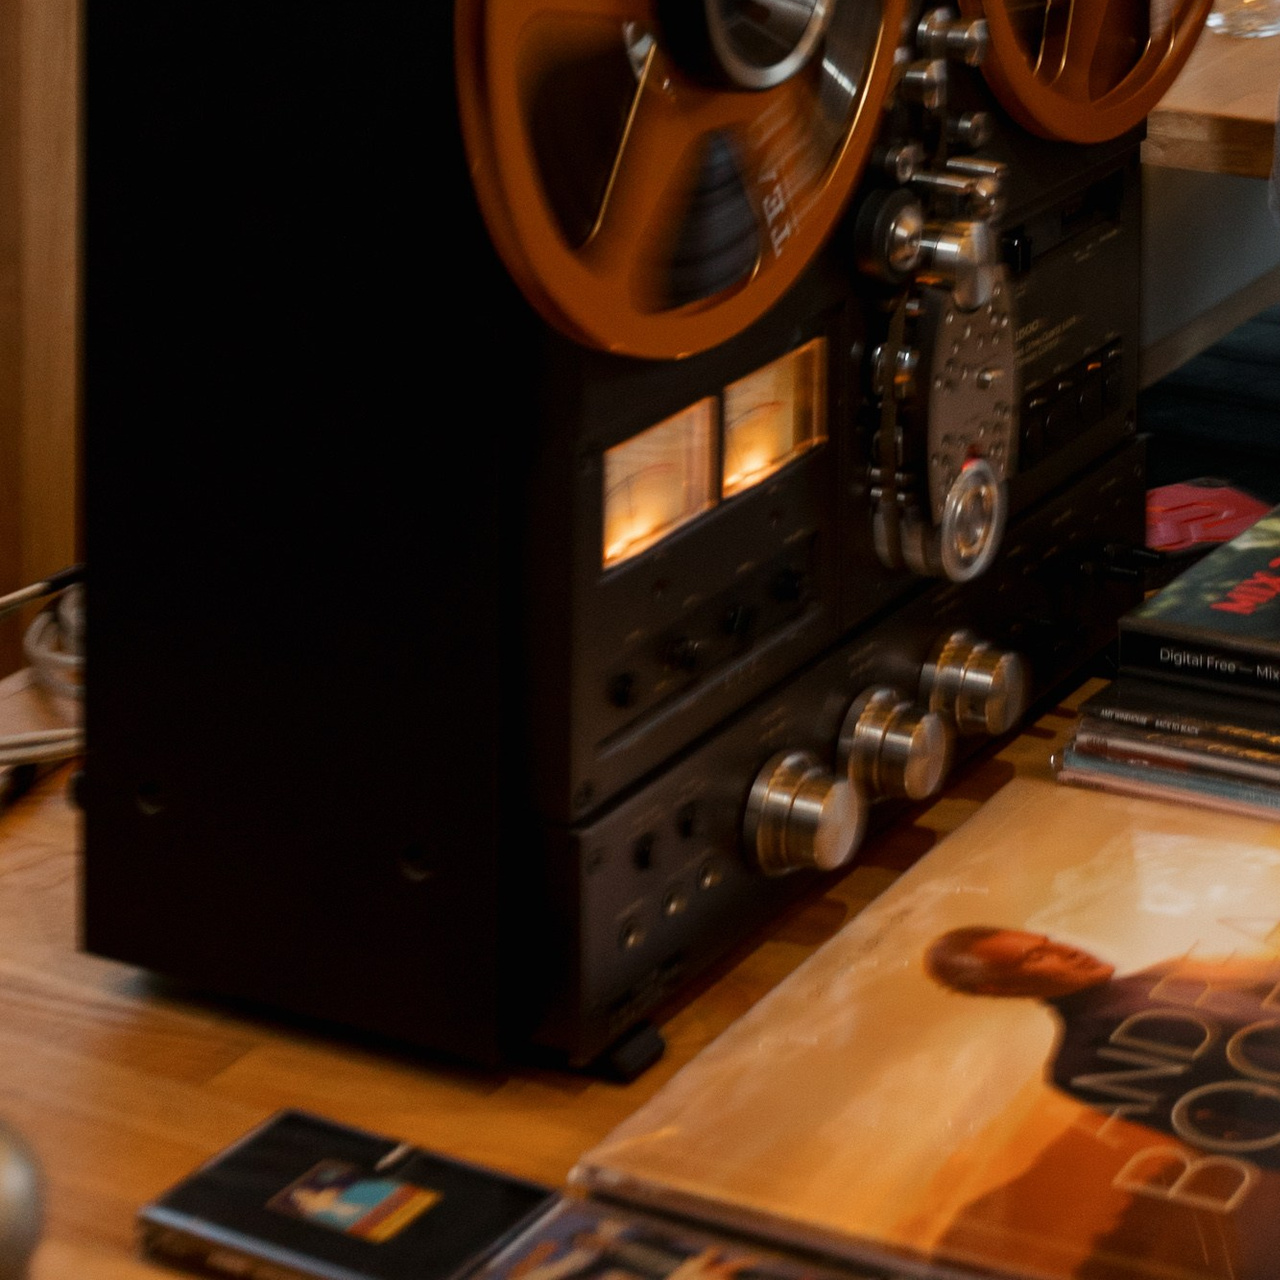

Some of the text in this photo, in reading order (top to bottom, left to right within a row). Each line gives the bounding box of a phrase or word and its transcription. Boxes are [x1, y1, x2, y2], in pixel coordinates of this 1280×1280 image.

[1159, 646, 1204, 669] Digital
[1206, 653, 1236, 674] Free
[1256, 664, 1280, 683] Mix
